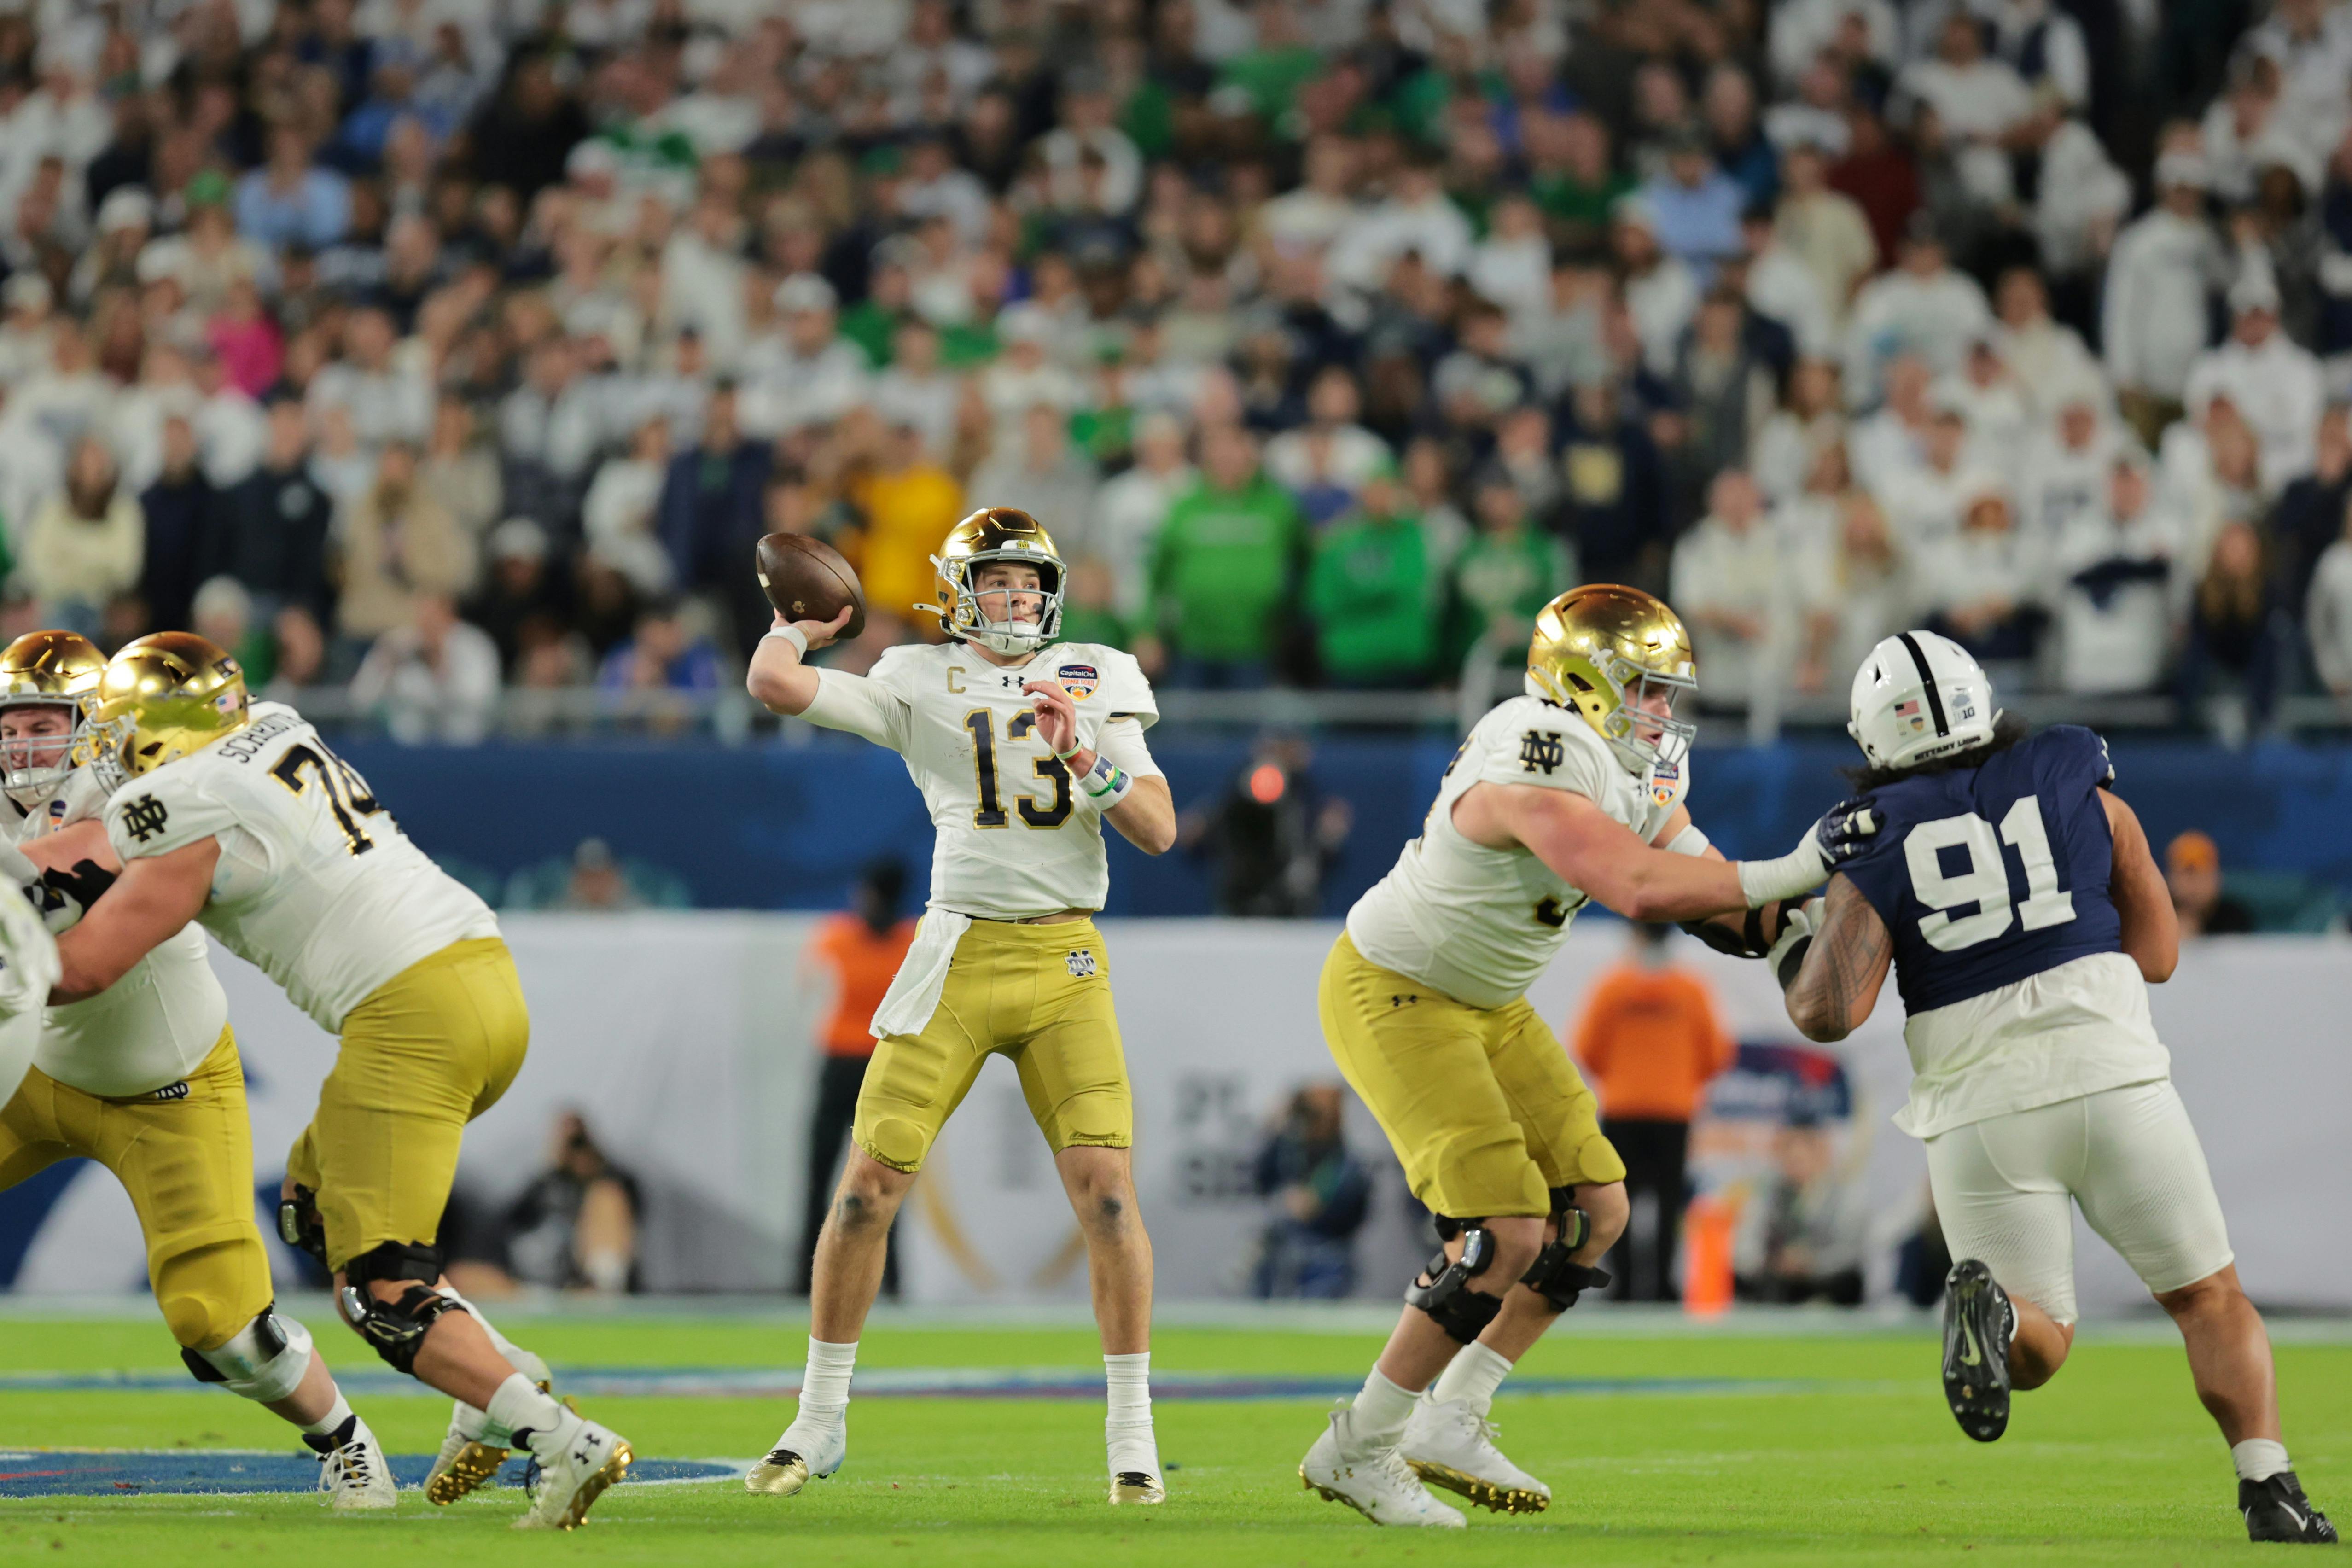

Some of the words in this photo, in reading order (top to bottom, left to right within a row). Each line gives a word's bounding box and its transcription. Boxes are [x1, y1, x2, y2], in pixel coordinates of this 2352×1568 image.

[946, 666, 966, 694] C
[962, 707, 1075, 830] 13
[1903, 794, 2077, 953] 91
